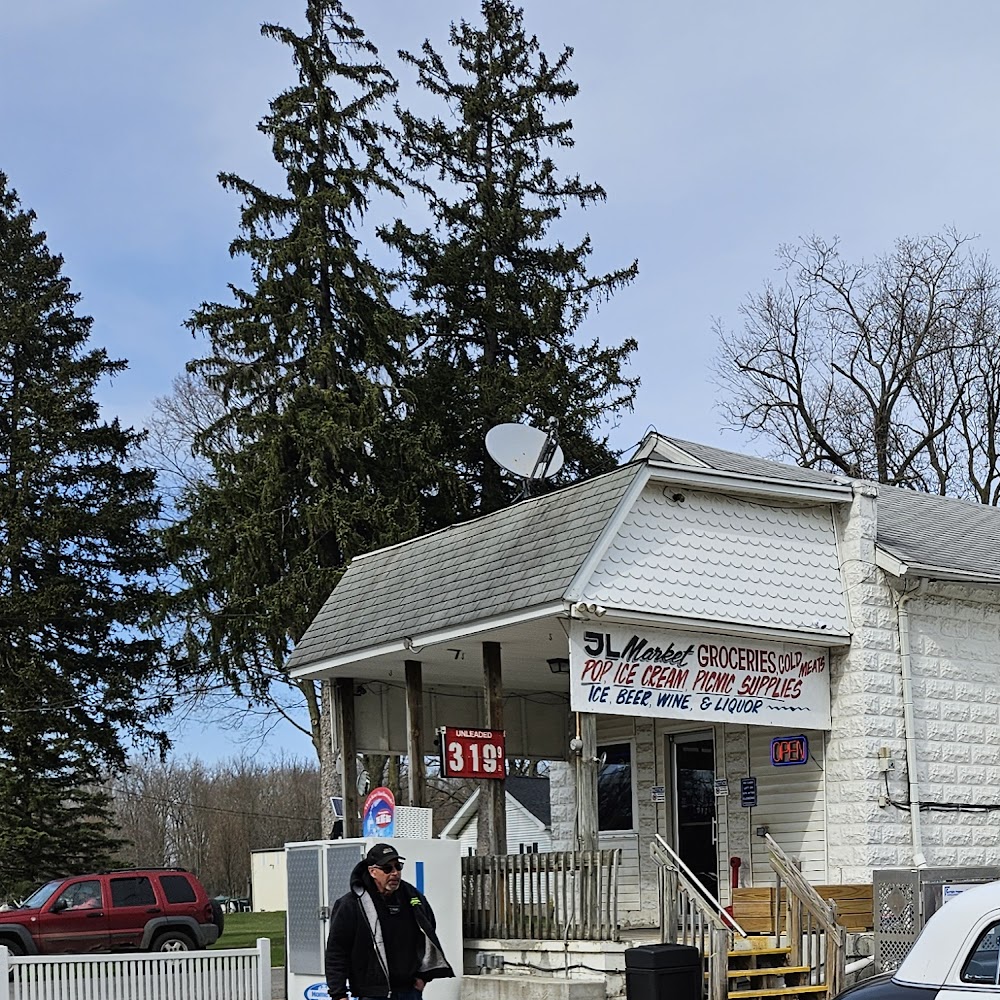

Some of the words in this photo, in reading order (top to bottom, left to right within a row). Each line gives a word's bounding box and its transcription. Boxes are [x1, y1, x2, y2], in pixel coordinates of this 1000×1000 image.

[584, 631, 620, 660] JL
[621, 635, 695, 667] Market
[697, 644, 779, 675] GROCERIES,
[778, 651, 802, 675] COLD
[798, 656, 826, 677] MEATS
[581, 659, 613, 684] POP,
[613, 662, 640, 685] ICE
[641, 665, 690, 692] CREAM,
[692, 670, 735, 693] PICNIC
[737, 675, 803, 699] SUPPLIES
[588, 685, 612, 705] ICE,
[616, 688, 653, 708] BEER,
[656, 692, 693, 711] WINE,
[700, 697, 712, 711] &
[714, 697, 763, 714] LIQUOR
[455, 730, 493, 739] UNLEADED
[772, 740, 804, 763] OPEN
